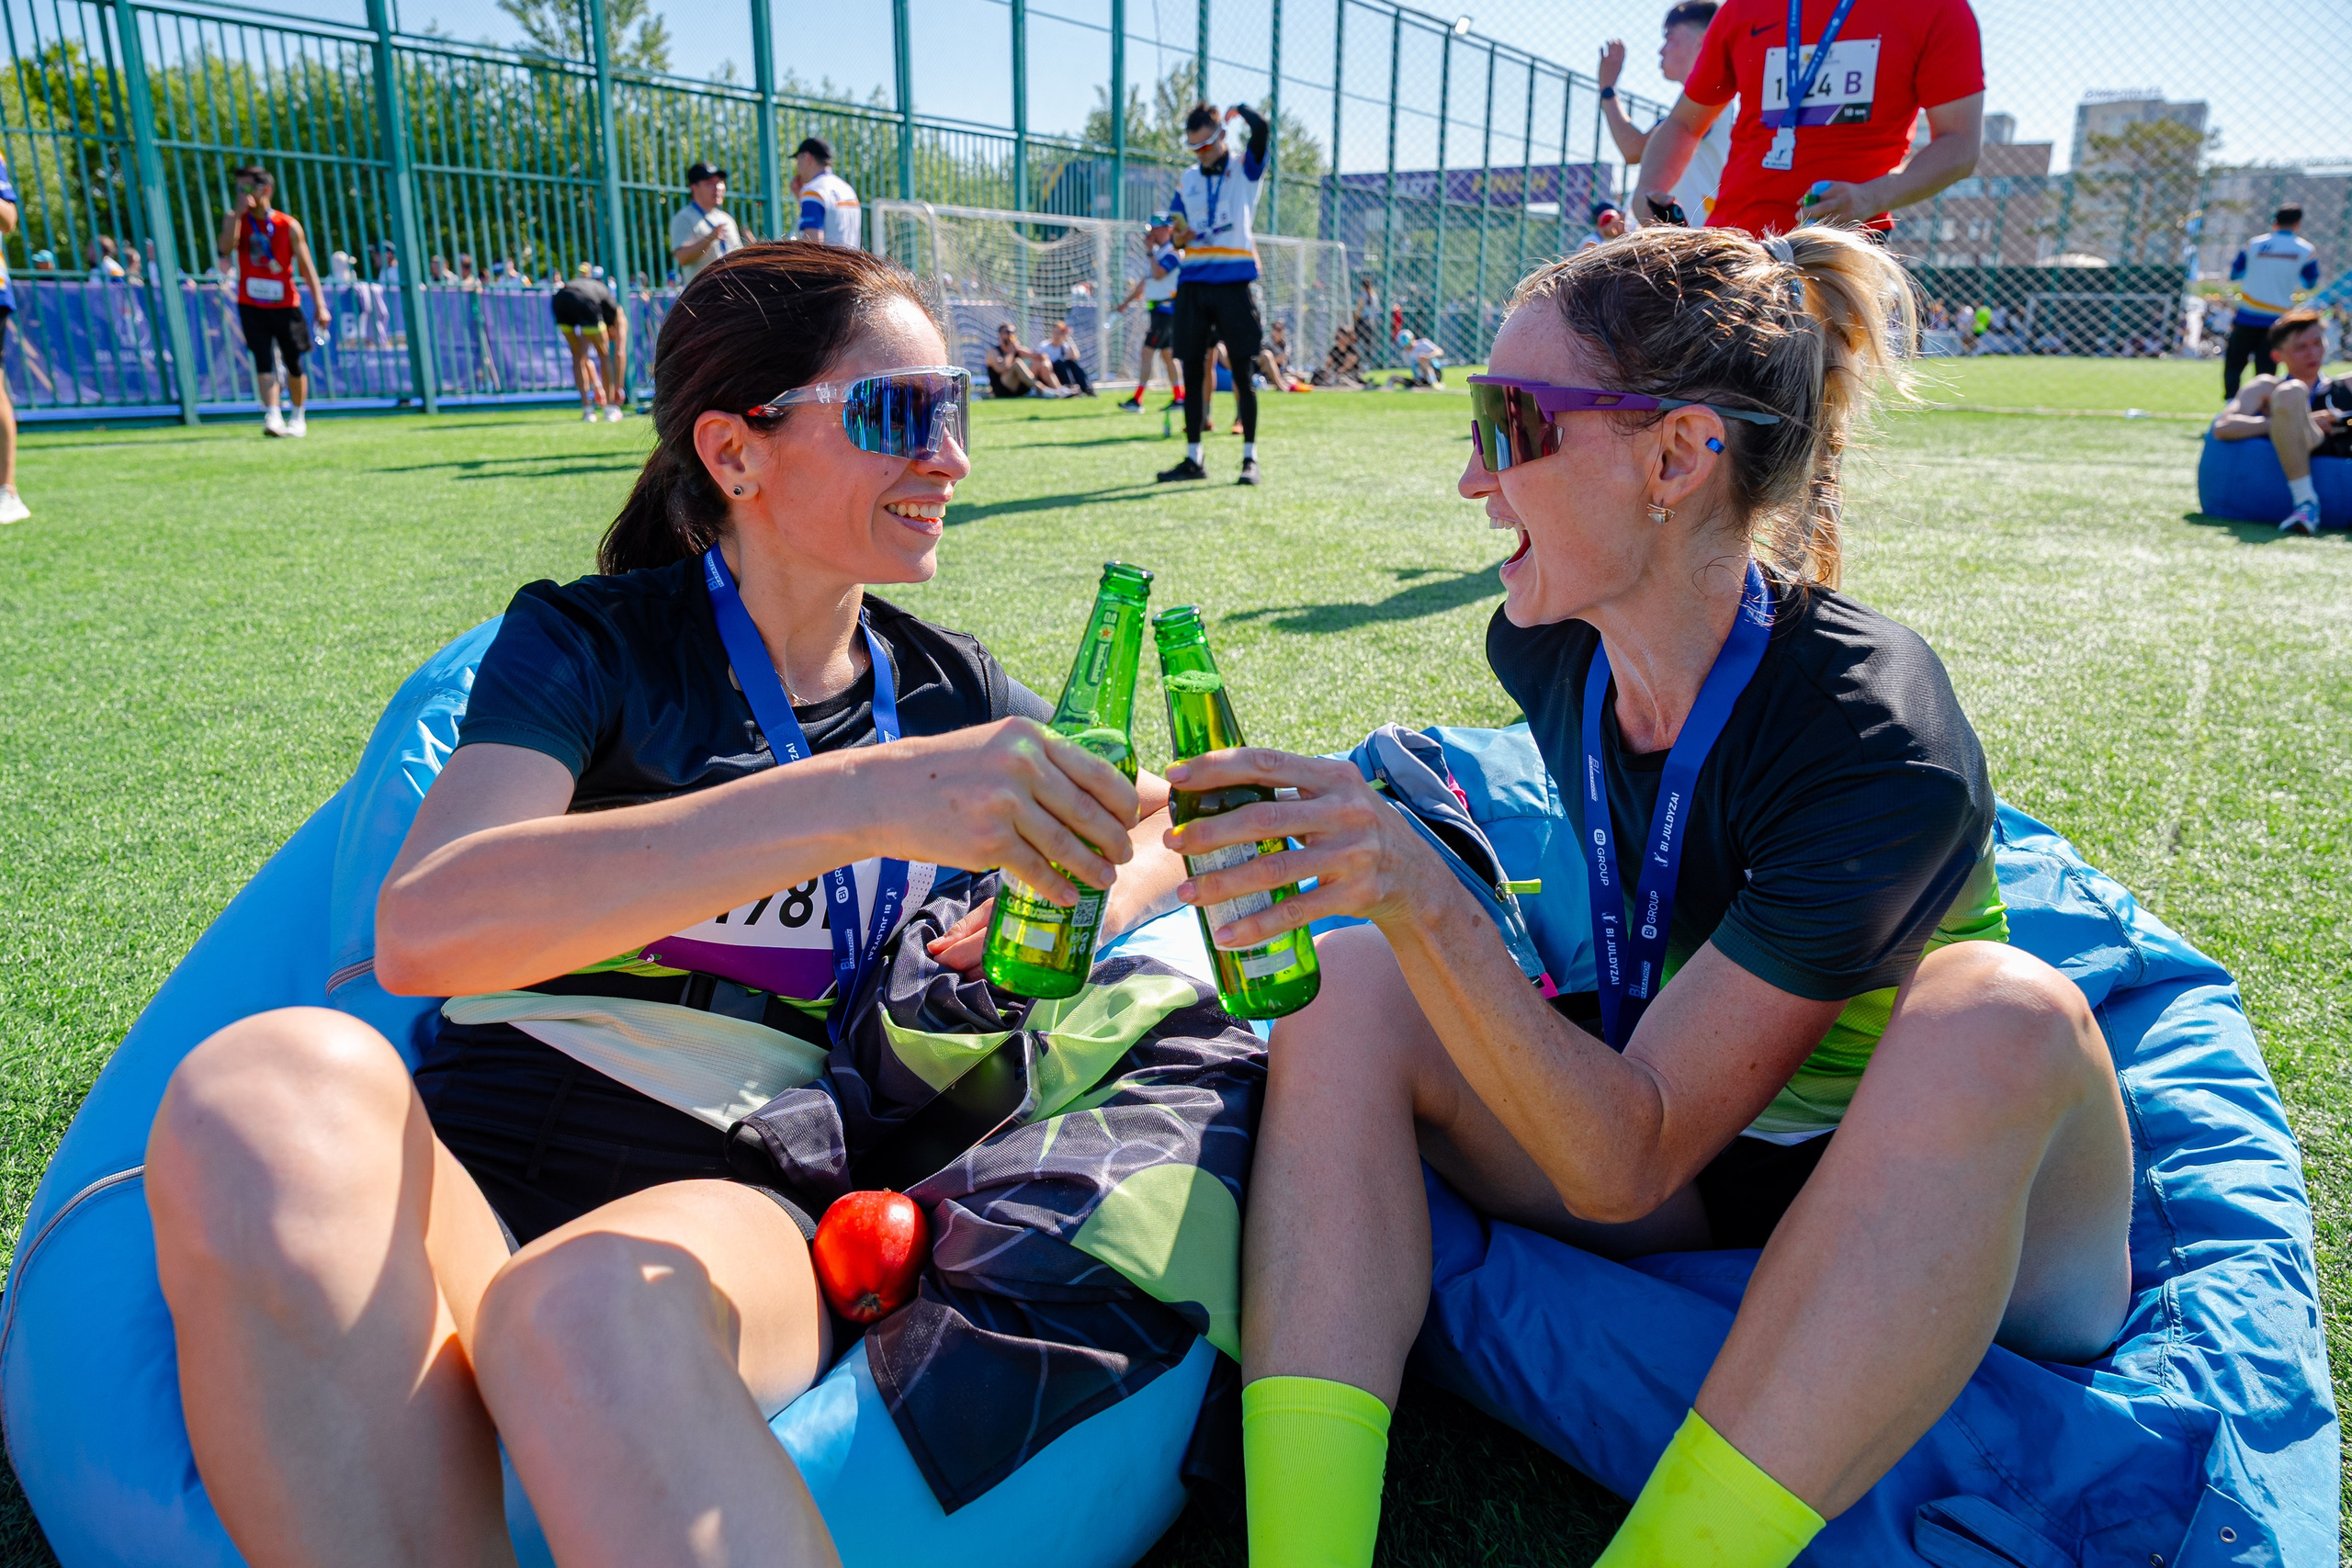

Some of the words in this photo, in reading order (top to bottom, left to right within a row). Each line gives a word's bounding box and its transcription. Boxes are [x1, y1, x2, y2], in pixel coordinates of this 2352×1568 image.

[1775, 72, 1832, 101] 124
[1844, 71, 1862, 96] B
[1373, 176, 1435, 196] SART
[705, 577, 719, 592] BI
[786, 742, 800, 763] ZAI
[1663, 792, 1680, 840] JULDYZAI
[1595, 830, 1605, 844] BI
[1660, 840, 1669, 852] BI
[1597, 847, 1610, 886] GROUP
[834, 867, 844, 886] GR
[837, 887, 847, 902] BI
[884, 904, 892, 914] BI
[1646, 890, 1659, 924] GROUP
[1605, 928, 1615, 937] BI
[1643, 926, 1656, 938] BI
[840, 957, 851, 970] BI
[1607, 940, 1620, 985] JULDYZAI
[1628, 983, 1641, 998] BI
